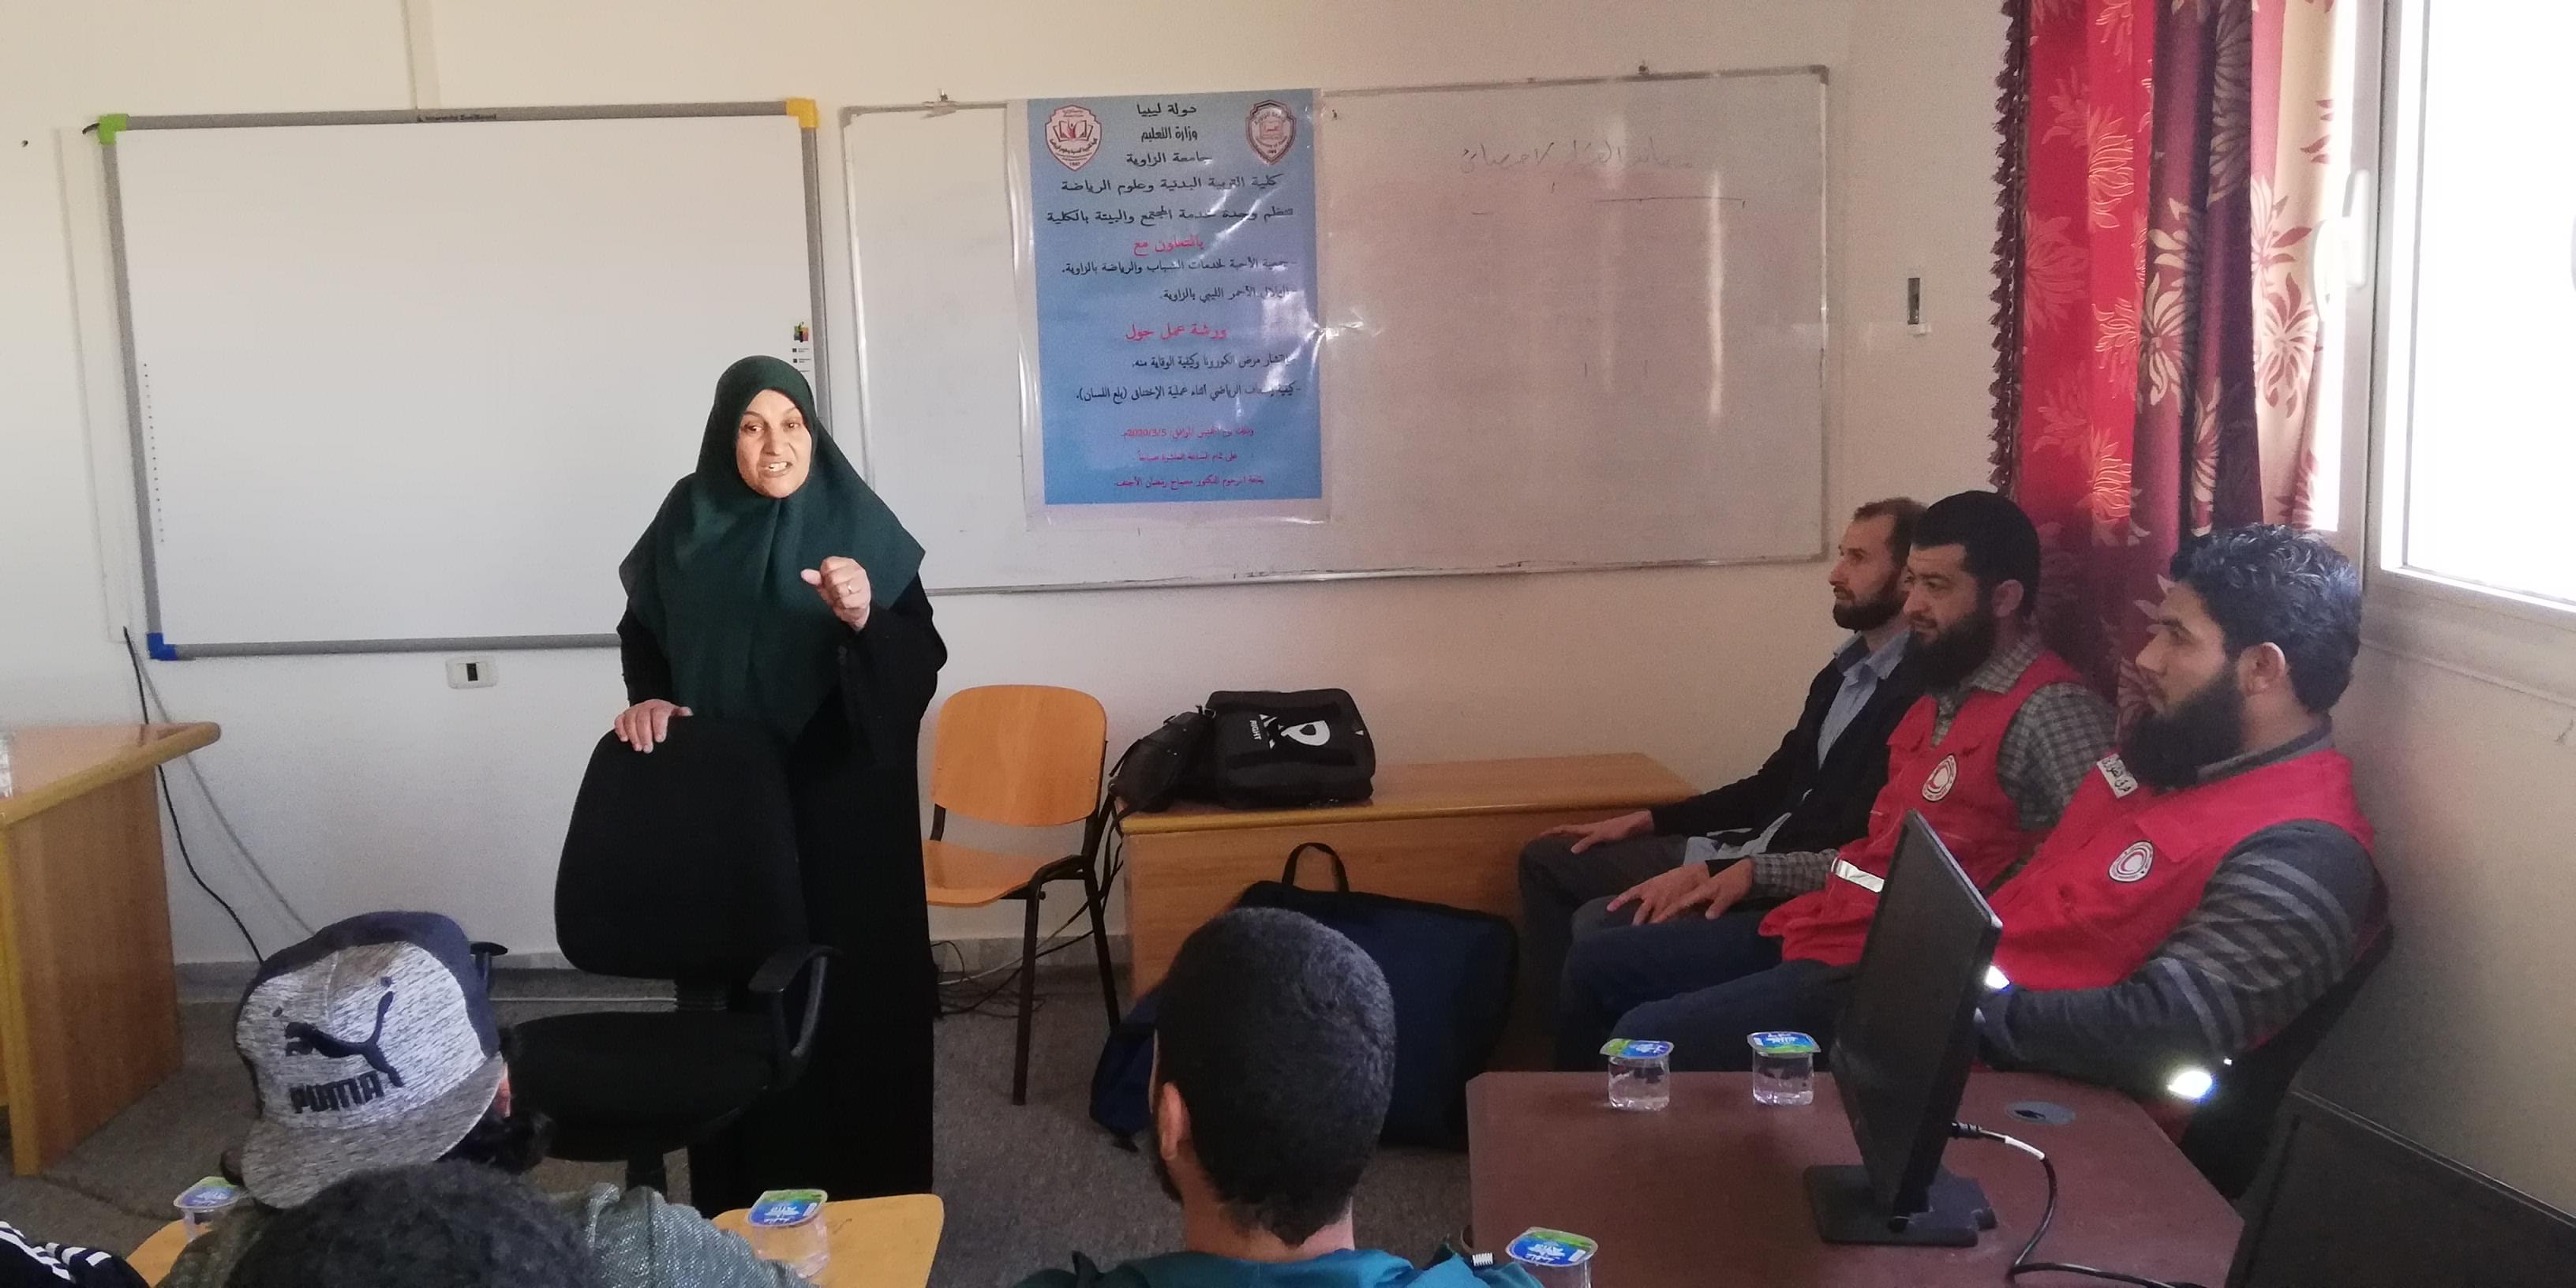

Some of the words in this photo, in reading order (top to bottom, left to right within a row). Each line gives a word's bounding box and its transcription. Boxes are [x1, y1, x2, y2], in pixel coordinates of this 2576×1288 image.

[1136, 102, 1162, 117] ليبيا
[1141, 126, 1172, 142] التعليم
[1175, 125, 1198, 141] وزارة
[1126, 151, 1166, 167] الزاوية
[1061, 179, 1111, 194] الرياضة
[1117, 178, 1154, 196] وعلوم
[1160, 176, 1202, 191] البدنية
[1208, 176, 1245, 190] التربية
[1251, 173, 1285, 189] كلية
[1046, 208, 1089, 224] بالكلية
[1140, 205, 1173, 227] المجتمع
[1133, 240, 1149, 256] مع
[1155, 234, 1204, 253] بالتعاون
[1101, 260, 1143, 275] والرياضة
[1188, 258, 1225, 270] لخدمات
[1125, 324, 1155, 341] حول
[1160, 322, 1185, 341] عمل
[1189, 323, 1227, 340] ورشة
[1151, 354, 1175, 369] الوقاية
[1238, 356, 1260, 369] مرض
[1210, 384, 1241, 401] الرياضي
[1249, 720, 1262, 740] RIGHT
[290, 1069, 384, 1114] PUMA
